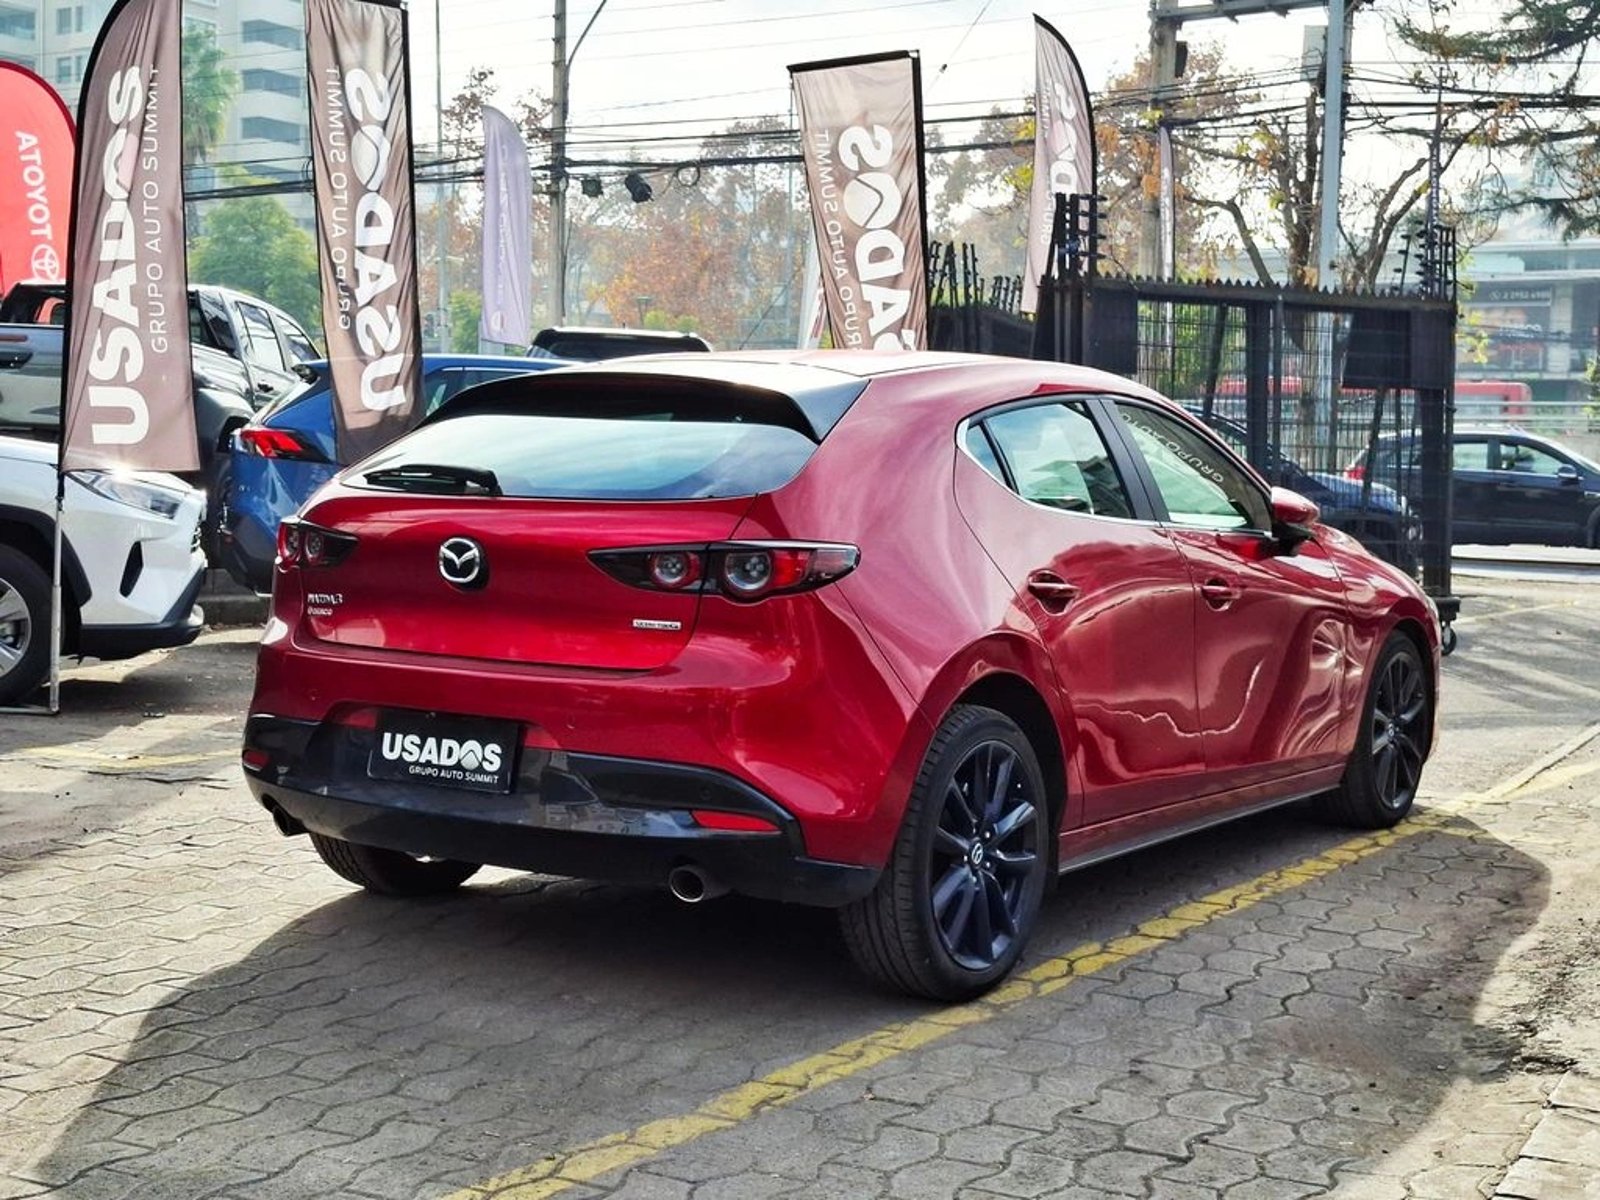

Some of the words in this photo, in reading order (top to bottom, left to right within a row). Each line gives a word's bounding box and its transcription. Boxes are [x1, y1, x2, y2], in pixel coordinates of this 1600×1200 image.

[143, 64, 160, 171] SUMMIT
[88, 65, 149, 445] USADOS
[143, 180, 162, 254] AUTO
[147, 262, 168, 354] GRUPO
[382, 732, 502, 772] USADOS
[409, 765, 438, 777] GRUPO
[440, 771, 463, 781] AUTO
[465, 772, 499, 784] SUMMIT
